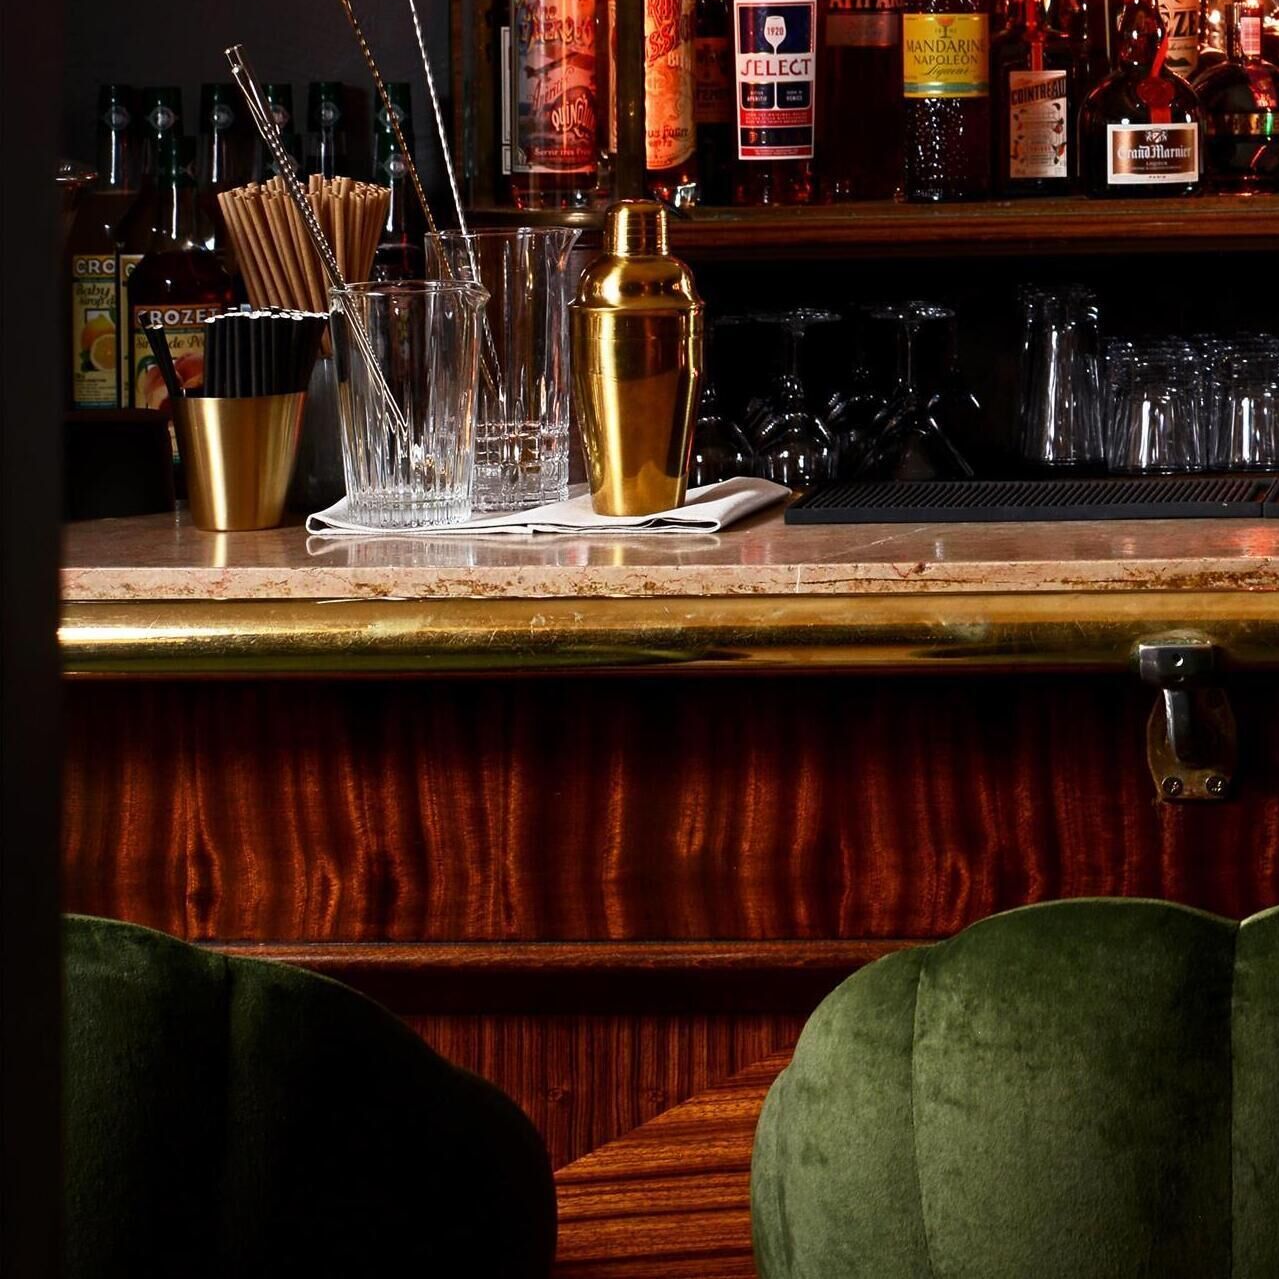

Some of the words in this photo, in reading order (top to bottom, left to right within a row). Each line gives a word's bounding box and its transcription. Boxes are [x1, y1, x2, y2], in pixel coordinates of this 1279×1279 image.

[767, 25, 785, 36] 1920
[906, 39, 986, 55] MANDARINE
[740, 58, 812, 77] SELECT
[1010, 76, 1067, 106] COINTREAU
[1117, 143, 1151, 160] Grand
[1150, 144, 1192, 159] Marnier
[75, 258, 116, 275] CRO
